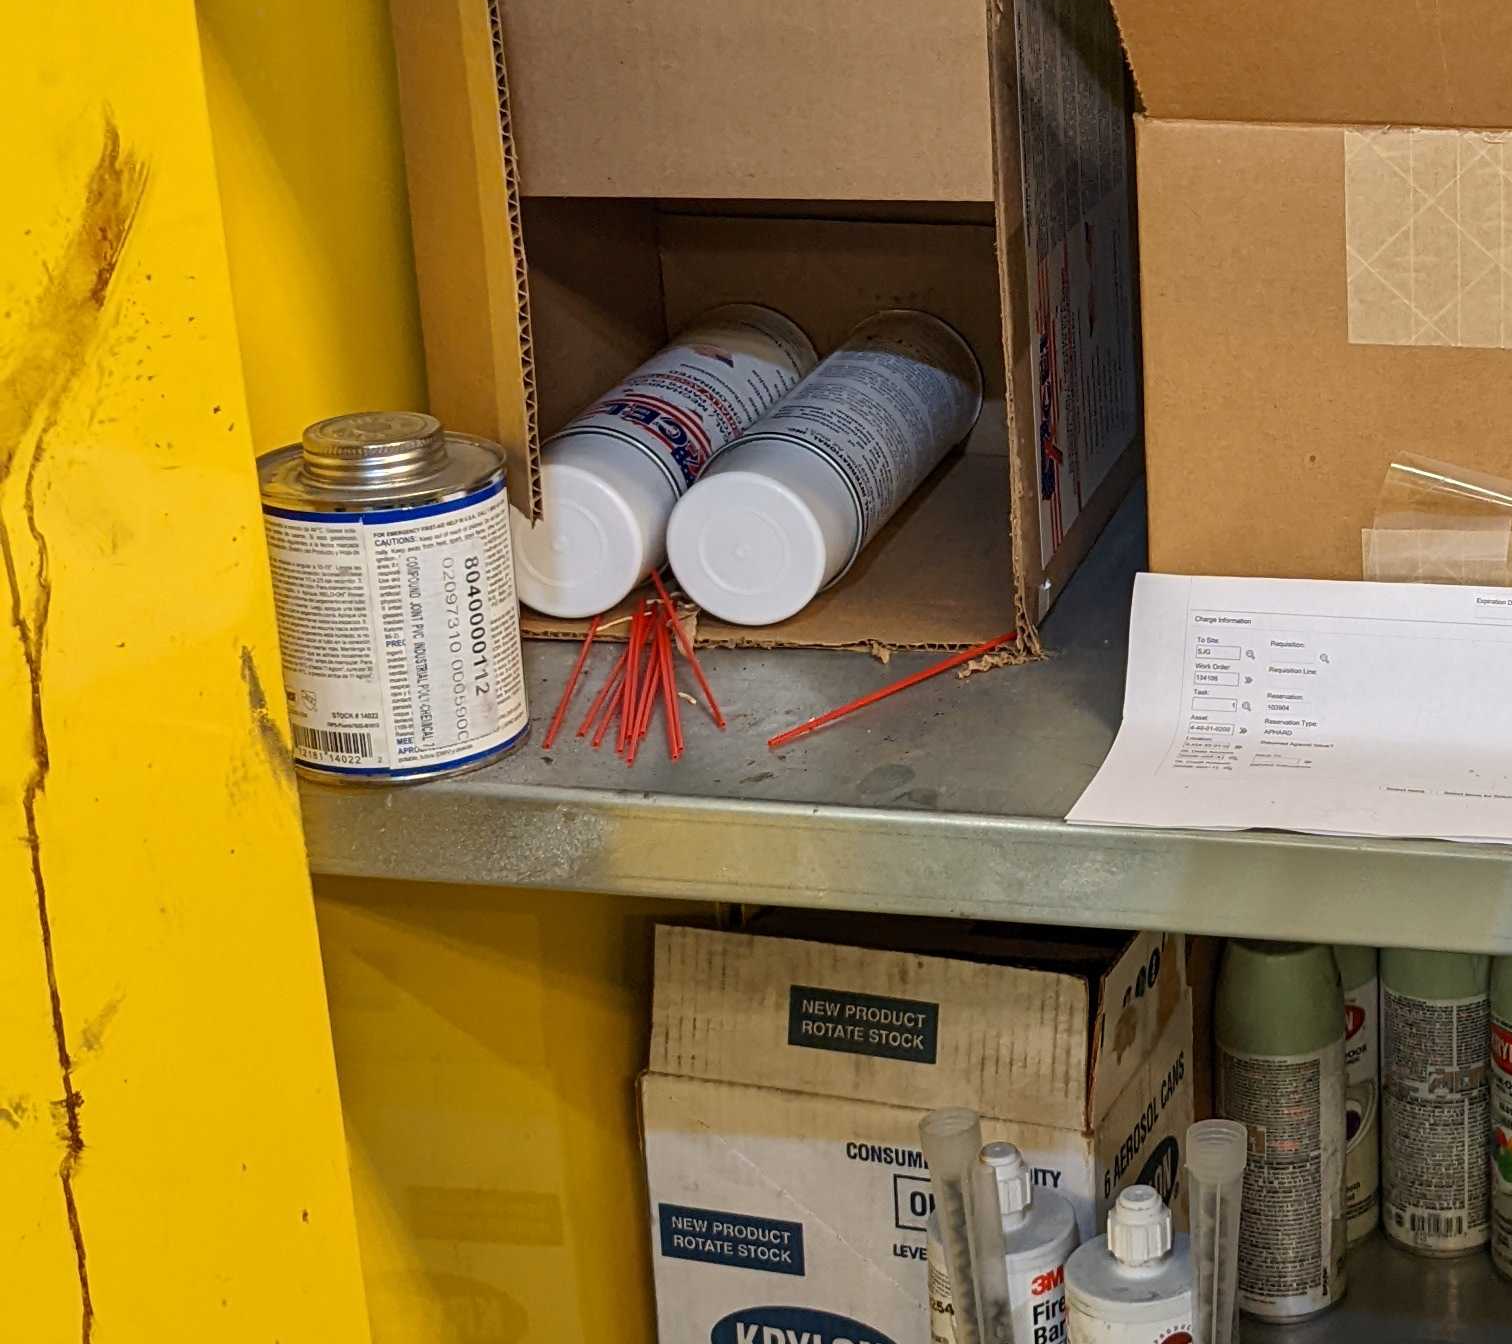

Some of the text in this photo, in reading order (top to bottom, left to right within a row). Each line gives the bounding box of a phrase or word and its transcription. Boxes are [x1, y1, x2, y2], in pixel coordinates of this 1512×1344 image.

[443, 557, 463, 653] 02097310
[464, 557, 490, 697] 8040000112
[801, 999, 926, 1029] NEW PRODUCT
[801, 1019, 925, 1049] ROTATE STOCK
[1114, 1054, 1186, 1184] AEROSOL CANS
[846, 1141, 929, 1169] CONSUM
[671, 1215, 792, 1245] NEW PRODUCT
[673, 1235, 792, 1265] ROTATE STOCK
